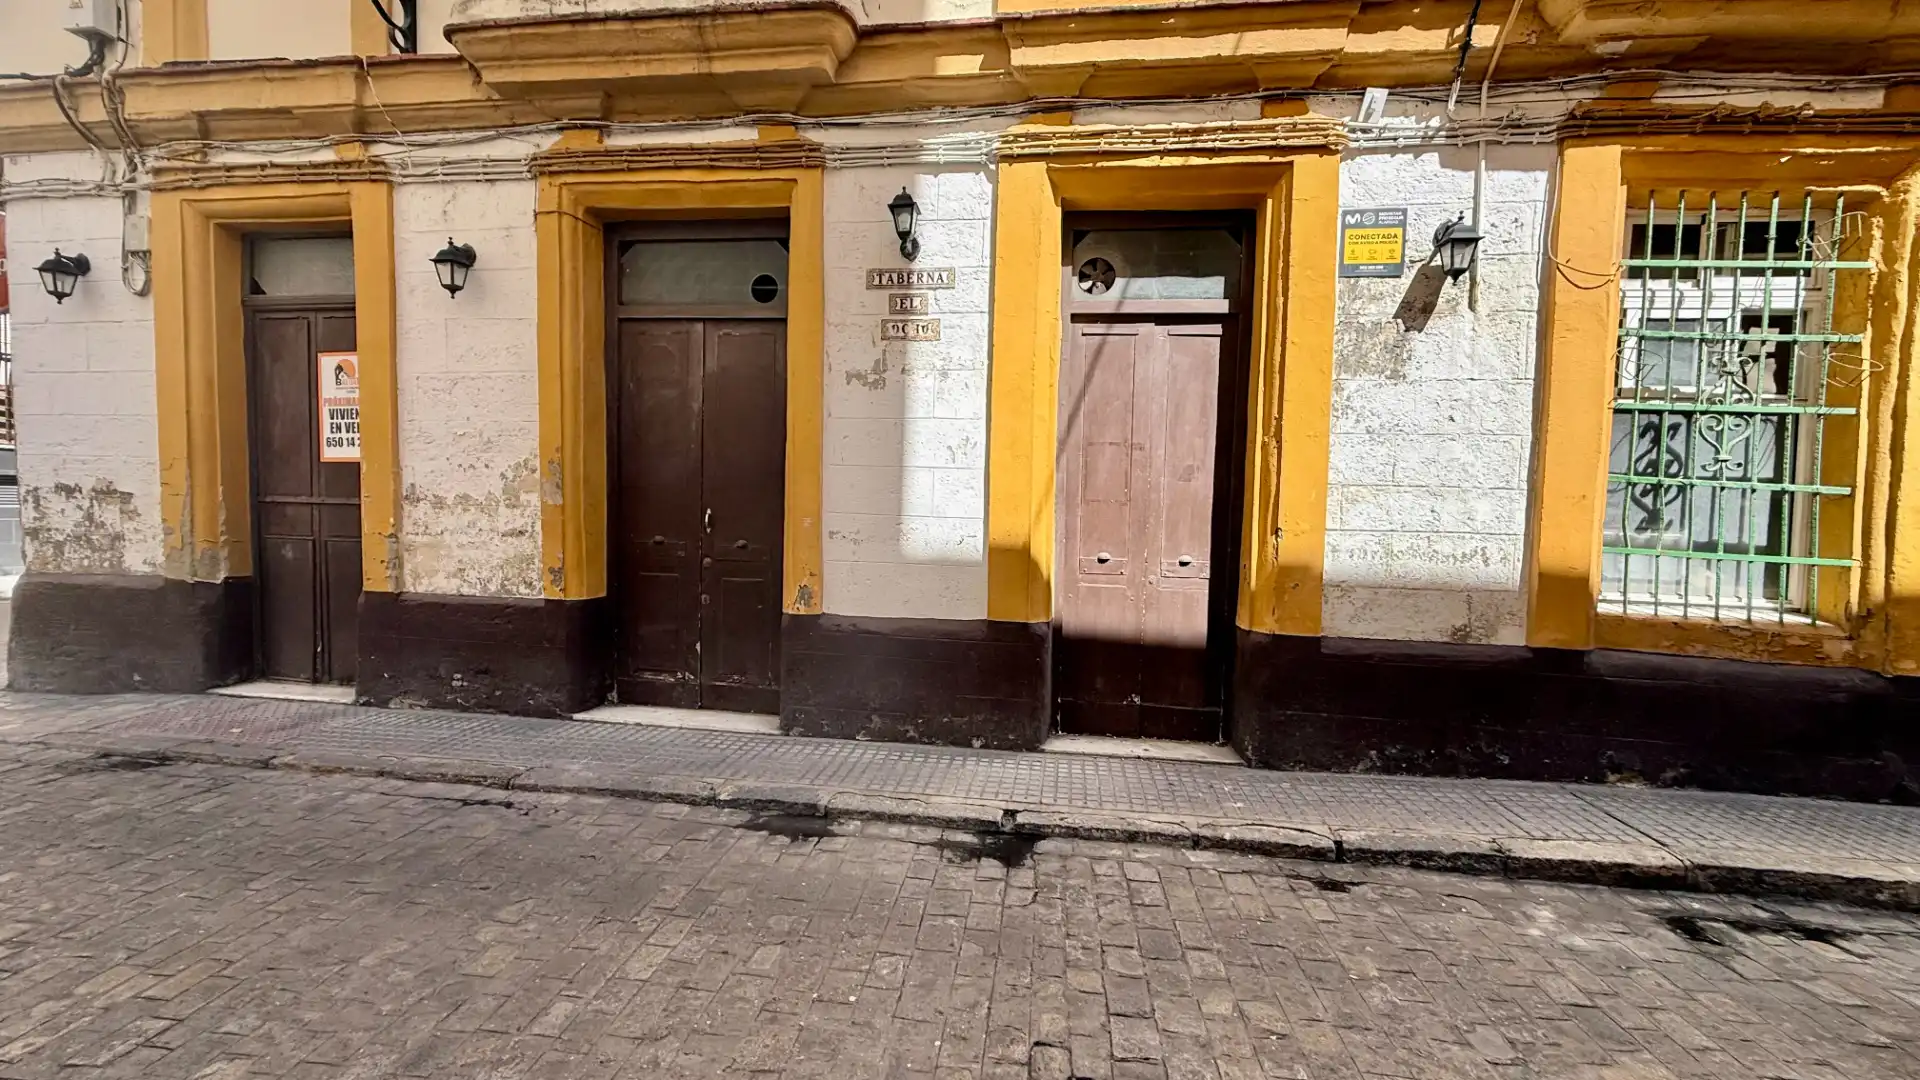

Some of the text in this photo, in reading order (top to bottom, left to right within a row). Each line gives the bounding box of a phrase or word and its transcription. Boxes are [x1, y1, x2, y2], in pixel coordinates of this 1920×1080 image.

[1348, 233, 1398, 241] CONECTADA
[876, 272, 945, 285] TABERNA
[900, 298, 917, 309] EL
[330, 422, 342, 434] EN
[326, 437, 344, 448] 650
[345, 437, 356, 447] 14
